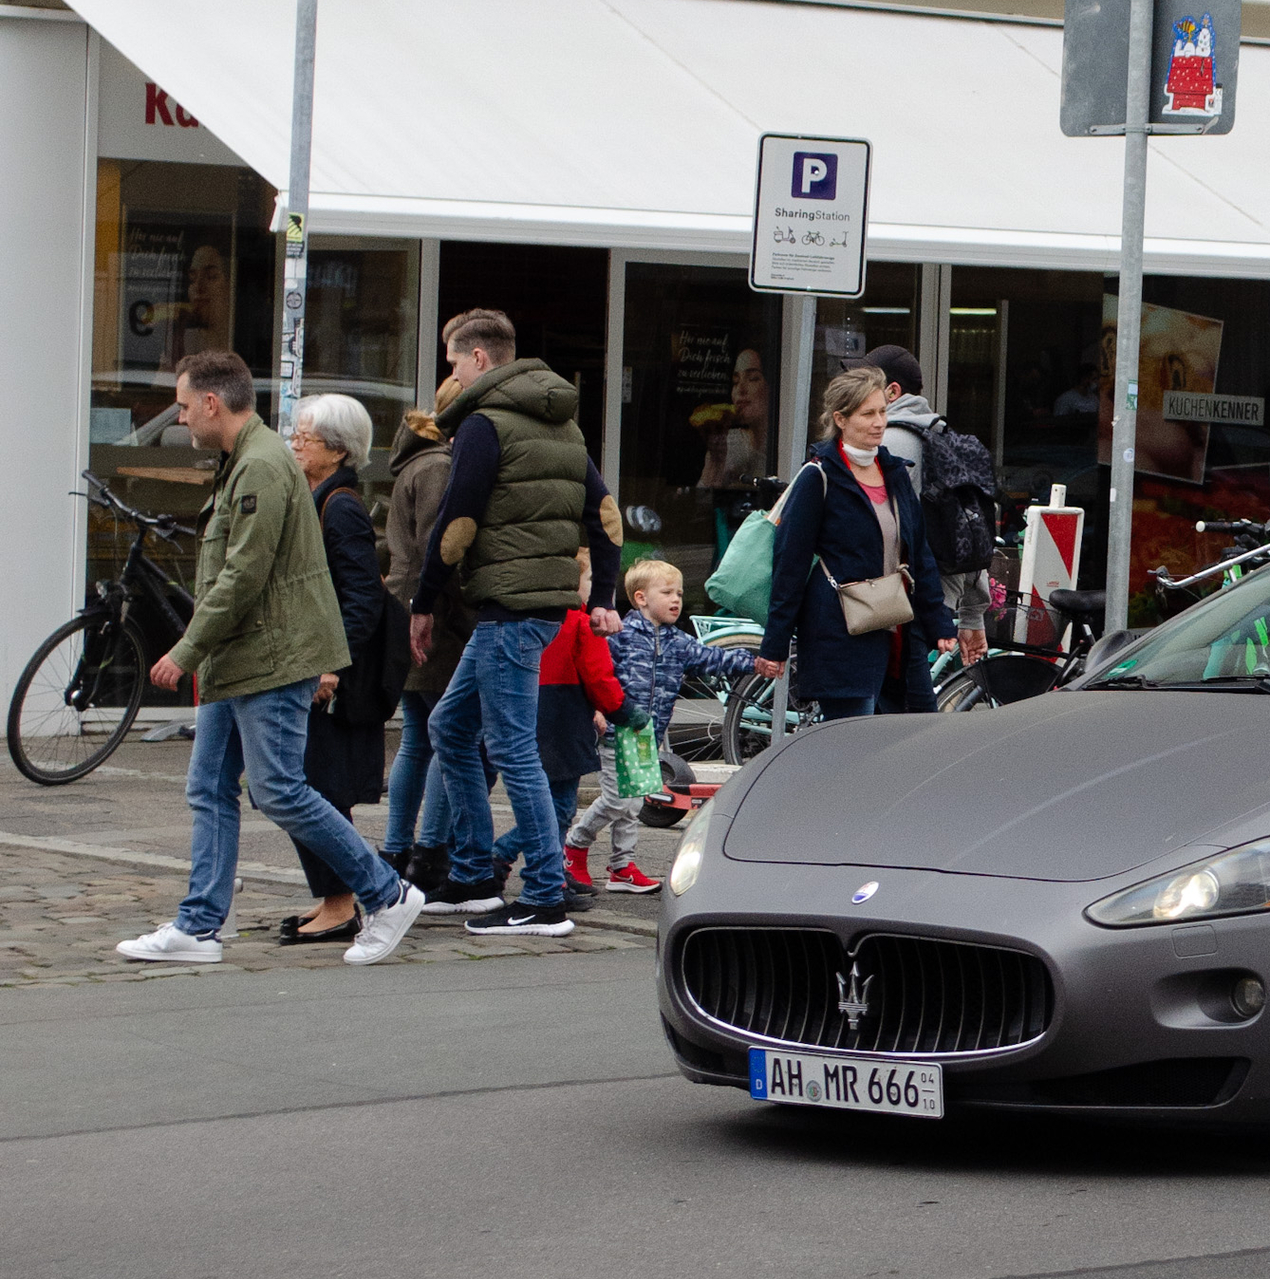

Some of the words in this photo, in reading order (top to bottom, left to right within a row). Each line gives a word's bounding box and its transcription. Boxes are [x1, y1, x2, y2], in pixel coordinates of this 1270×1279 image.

[801, 158, 828, 194] P
[774, 207, 851, 222] SharingStation
[1168, 396, 1260, 421] KUCHENKENNER
[755, 1078, 763, 1090] D
[770, 1057, 804, 1097] AH
[823, 1063, 860, 1103] MR
[867, 1067, 919, 1108] 666
[920, 1072, 935, 1085] 04
[922, 1098, 936, 1110] 10
